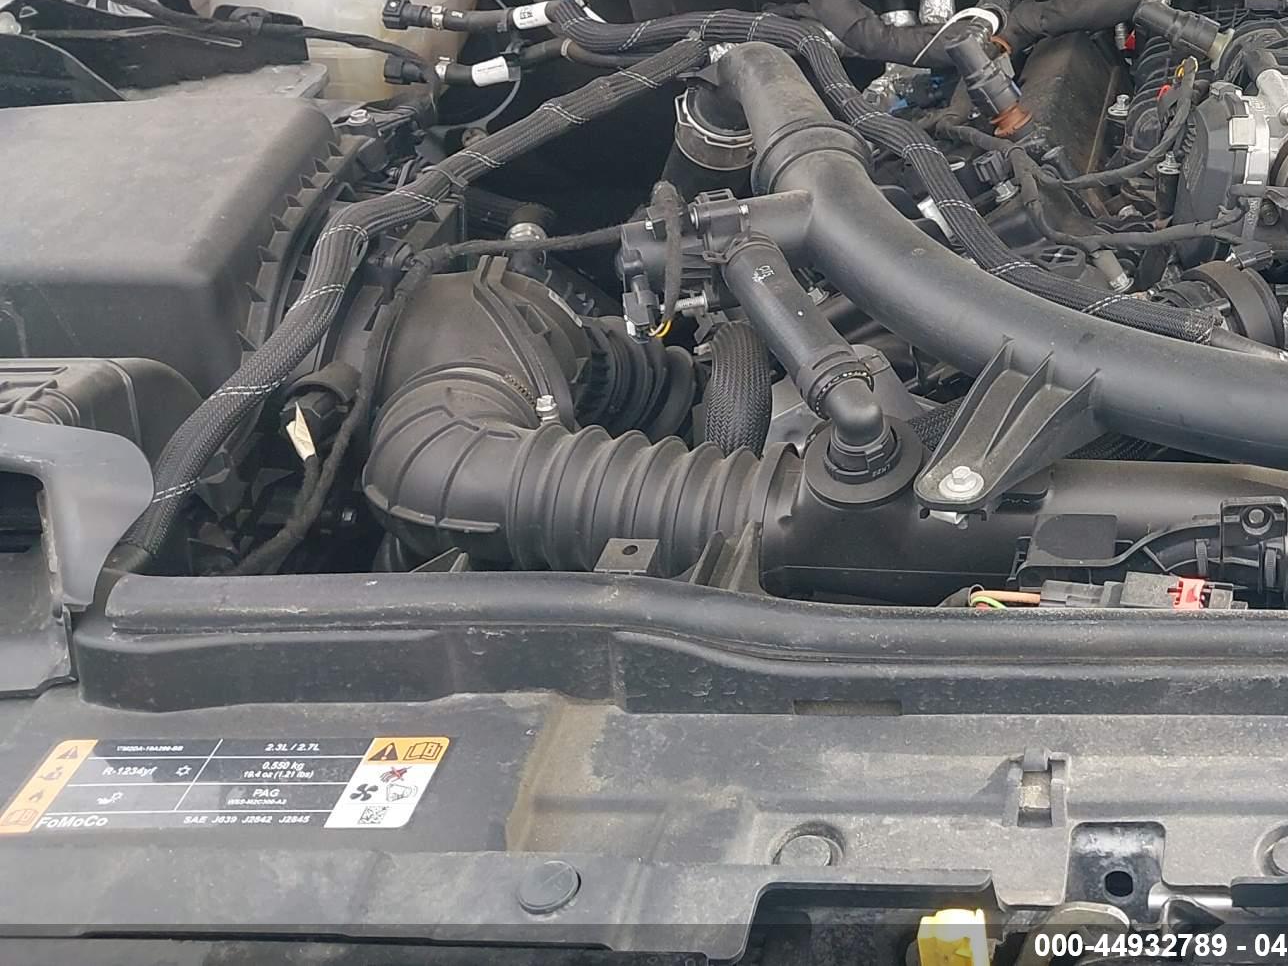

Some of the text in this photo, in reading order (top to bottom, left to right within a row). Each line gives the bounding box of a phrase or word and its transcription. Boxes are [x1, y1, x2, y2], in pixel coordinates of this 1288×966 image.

[265, 743, 288, 752] 2.3L
[297, 743, 320, 752] 2.7L
[102, 766, 158, 778] R-1234yf
[252, 788, 280, 798] PAG
[35, 815, 109, 829] FoMoCo
[183, 816, 208, 824] SAE
